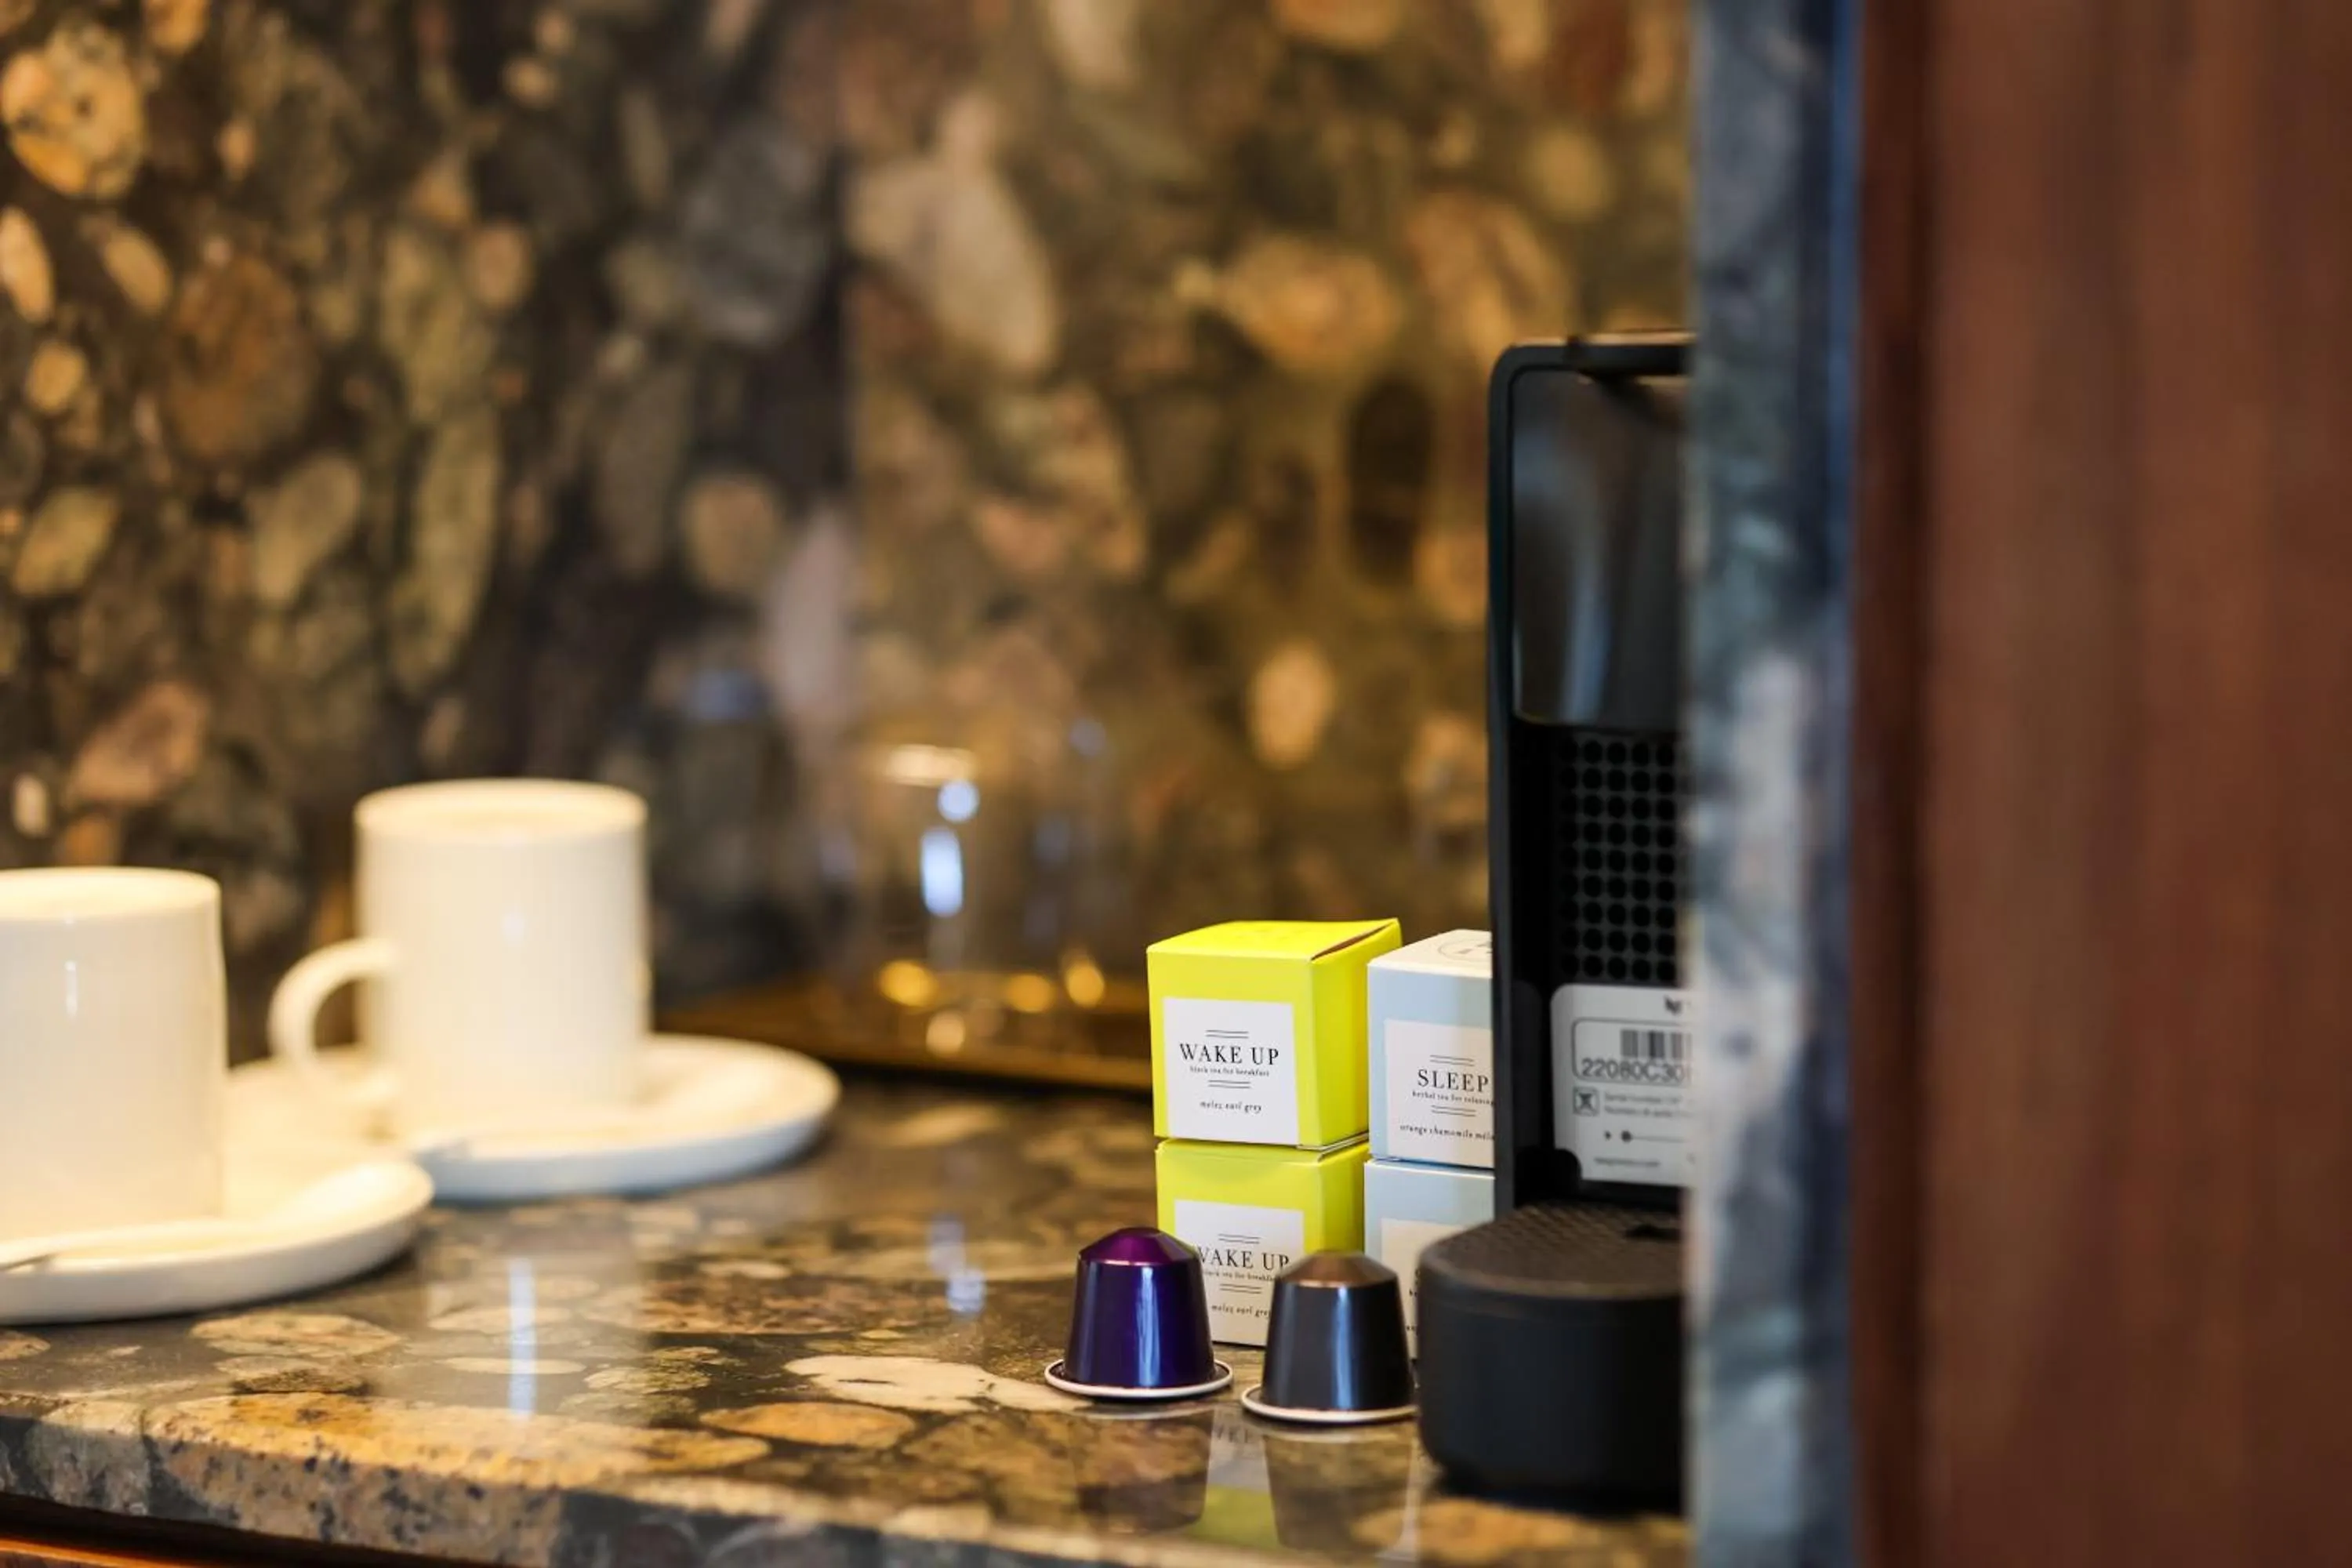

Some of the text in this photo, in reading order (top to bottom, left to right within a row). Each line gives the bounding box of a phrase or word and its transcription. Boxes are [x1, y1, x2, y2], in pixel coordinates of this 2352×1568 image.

[1179, 1043, 1279, 1065] WAKE UP
[1235, 1068, 1270, 1077] breakfast
[1417, 1069, 1488, 1092] SLEEP
[1412, 1090, 1436, 1098] herbal
[1243, 1104, 1262, 1114] grey
[1399, 1125, 1427, 1135] orange
[1429, 1124, 1473, 1138] chamomile
[1261, 1252, 1290, 1271] UP
